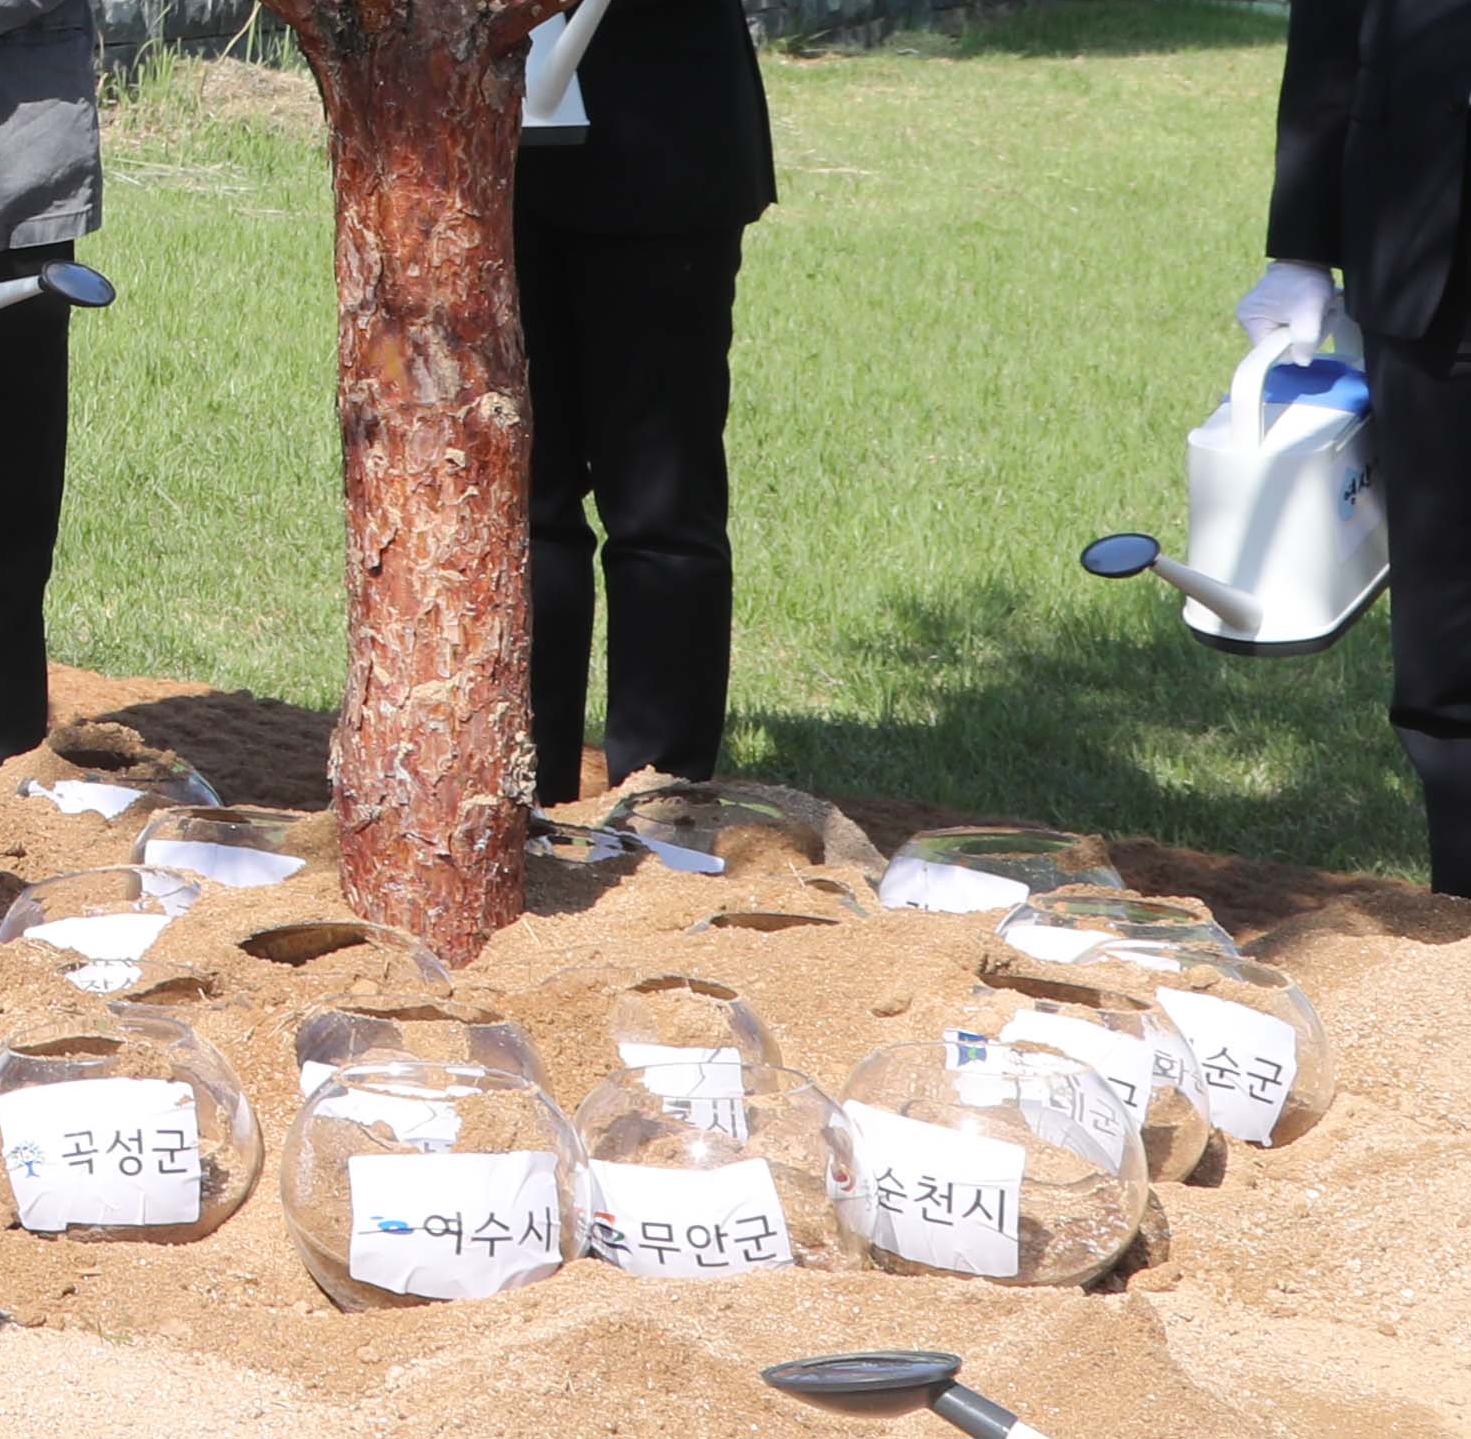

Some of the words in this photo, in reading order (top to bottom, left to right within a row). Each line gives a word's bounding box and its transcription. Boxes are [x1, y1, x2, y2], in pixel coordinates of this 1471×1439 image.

[61, 1128, 193, 1177] 곡성군
[877, 1167, 1006, 1232] 순천시
[423, 1207, 559, 1257] 여수시
[638, 1214, 778, 1269] 무안군
